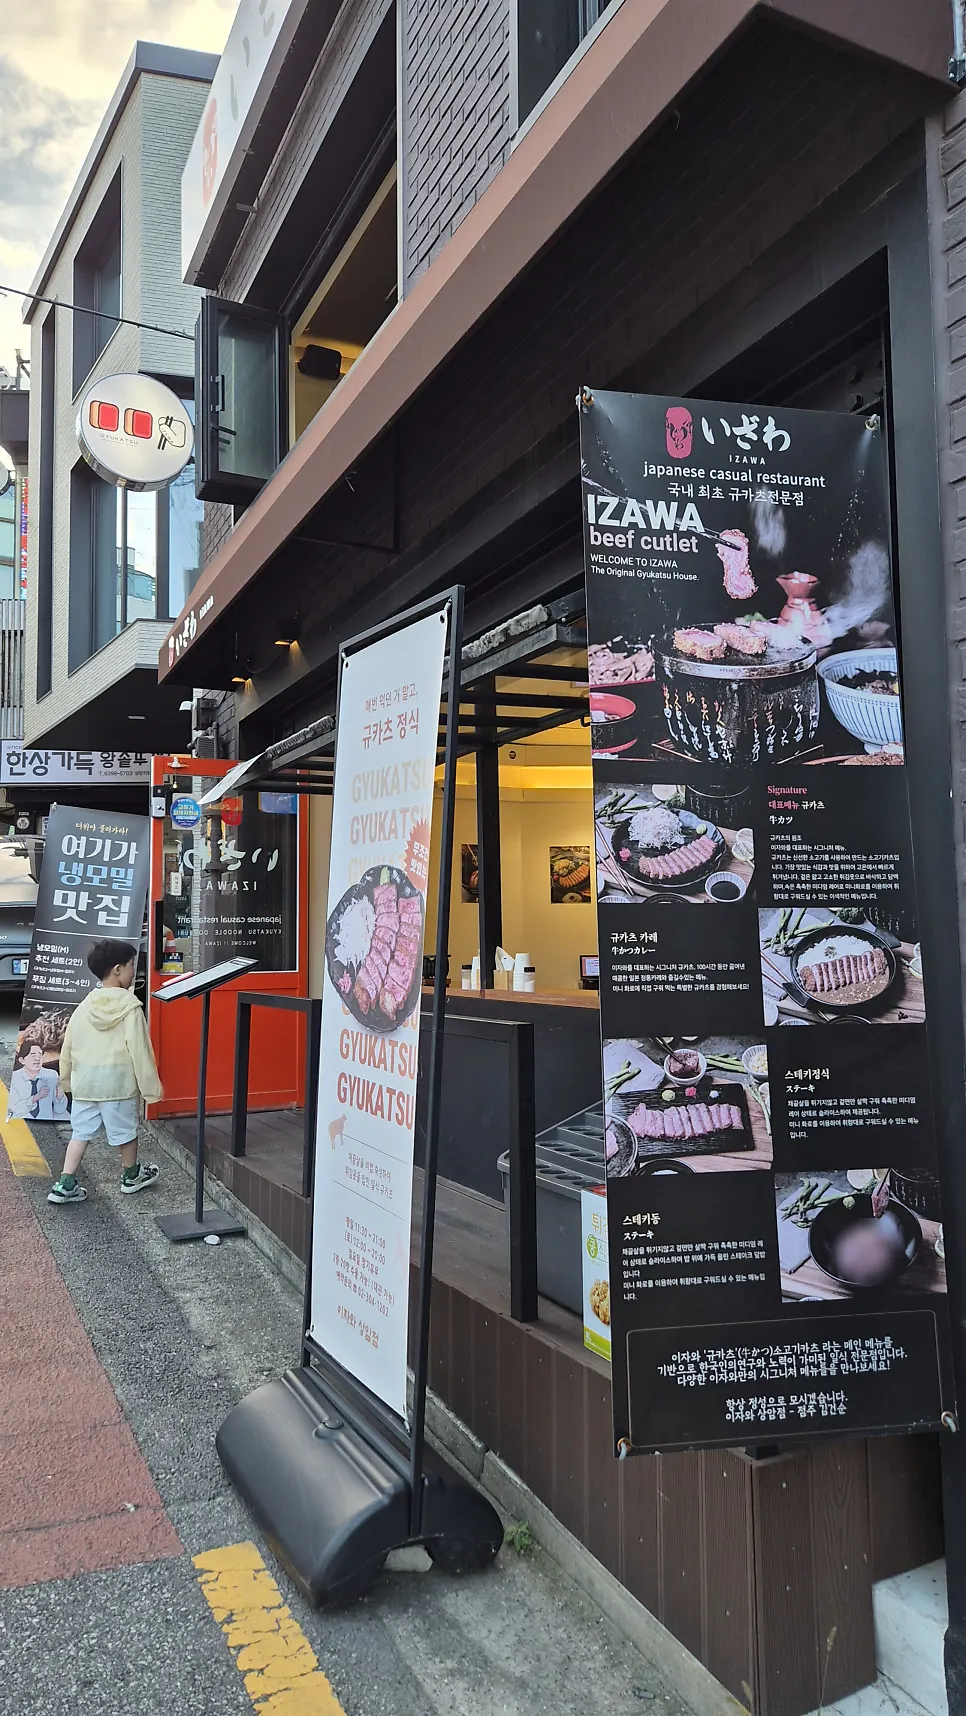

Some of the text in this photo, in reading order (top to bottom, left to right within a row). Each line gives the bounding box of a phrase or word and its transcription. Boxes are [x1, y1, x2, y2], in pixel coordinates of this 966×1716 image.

[100, 433, 139, 445] GYUKATSU
[702, 413, 792, 452] いざわ
[729, 454, 766, 466] IZAWA
[643, 460, 826, 488] japanese casual restaurant
[668, 482, 804, 507] 국내 최초 규카츠전문점
[586, 494, 706, 532] IZAWA
[589, 526, 699, 553] beef cutlet
[590, 553, 678, 569] WELCOME TO IZAWA
[590, 566, 700, 582] The Original Gyukatsu House.
[362, 708, 420, 750] 규카츠 정식
[6, 750, 95, 776] 한상가득
[767, 785, 808, 796] Signature
[768, 800, 826, 810] 대표메뉴 규카츠
[769, 815, 794, 825] 牛カツ
[61, 834, 139, 865] 여기가
[58, 861, 134, 891] 냉모밀
[53, 889, 131, 928] 맛집
[610, 932, 658, 944] 규카츠 카레
[50, 956, 84, 967] 세트(2인)
[339, 1028, 416, 1080] GYUKATSU
[784, 1068, 830, 1080] 스테키정식
[786, 1084, 816, 1094] ステーキ
[337, 1072, 414, 1130] GYUKATSU
[355, 1222, 368, 1237] 11:30
[622, 1212, 661, 1226] 스테키동
[623, 1230, 654, 1240] ステーキ
[671, 1349, 702, 1363] 이자와
[822, 1340, 841, 1352] 라는
[844, 1339, 862, 1352] 메인
[864, 1336, 893, 1350] 메뉴를
[657, 1361, 696, 1376] 기반으로
[768, 1354, 796, 1370] 노력이
[800, 1352, 828, 1367] 가미된
[830, 1351, 848, 1364] 일식
[850, 1347, 908, 1362] 전문점입니다.
[677, 1360, 891, 1388] 다양한 이자와만의 시그니처 메뉴들을 만나보세요!
[726, 1390, 849, 1412] 항상 정성으로 모시겠습니다.
[726, 1408, 755, 1423] 이자와
[757, 1406, 787, 1421] 상암점
[796, 1404, 818, 1418] 점주
[819, 1402, 848, 1416] 김건순
